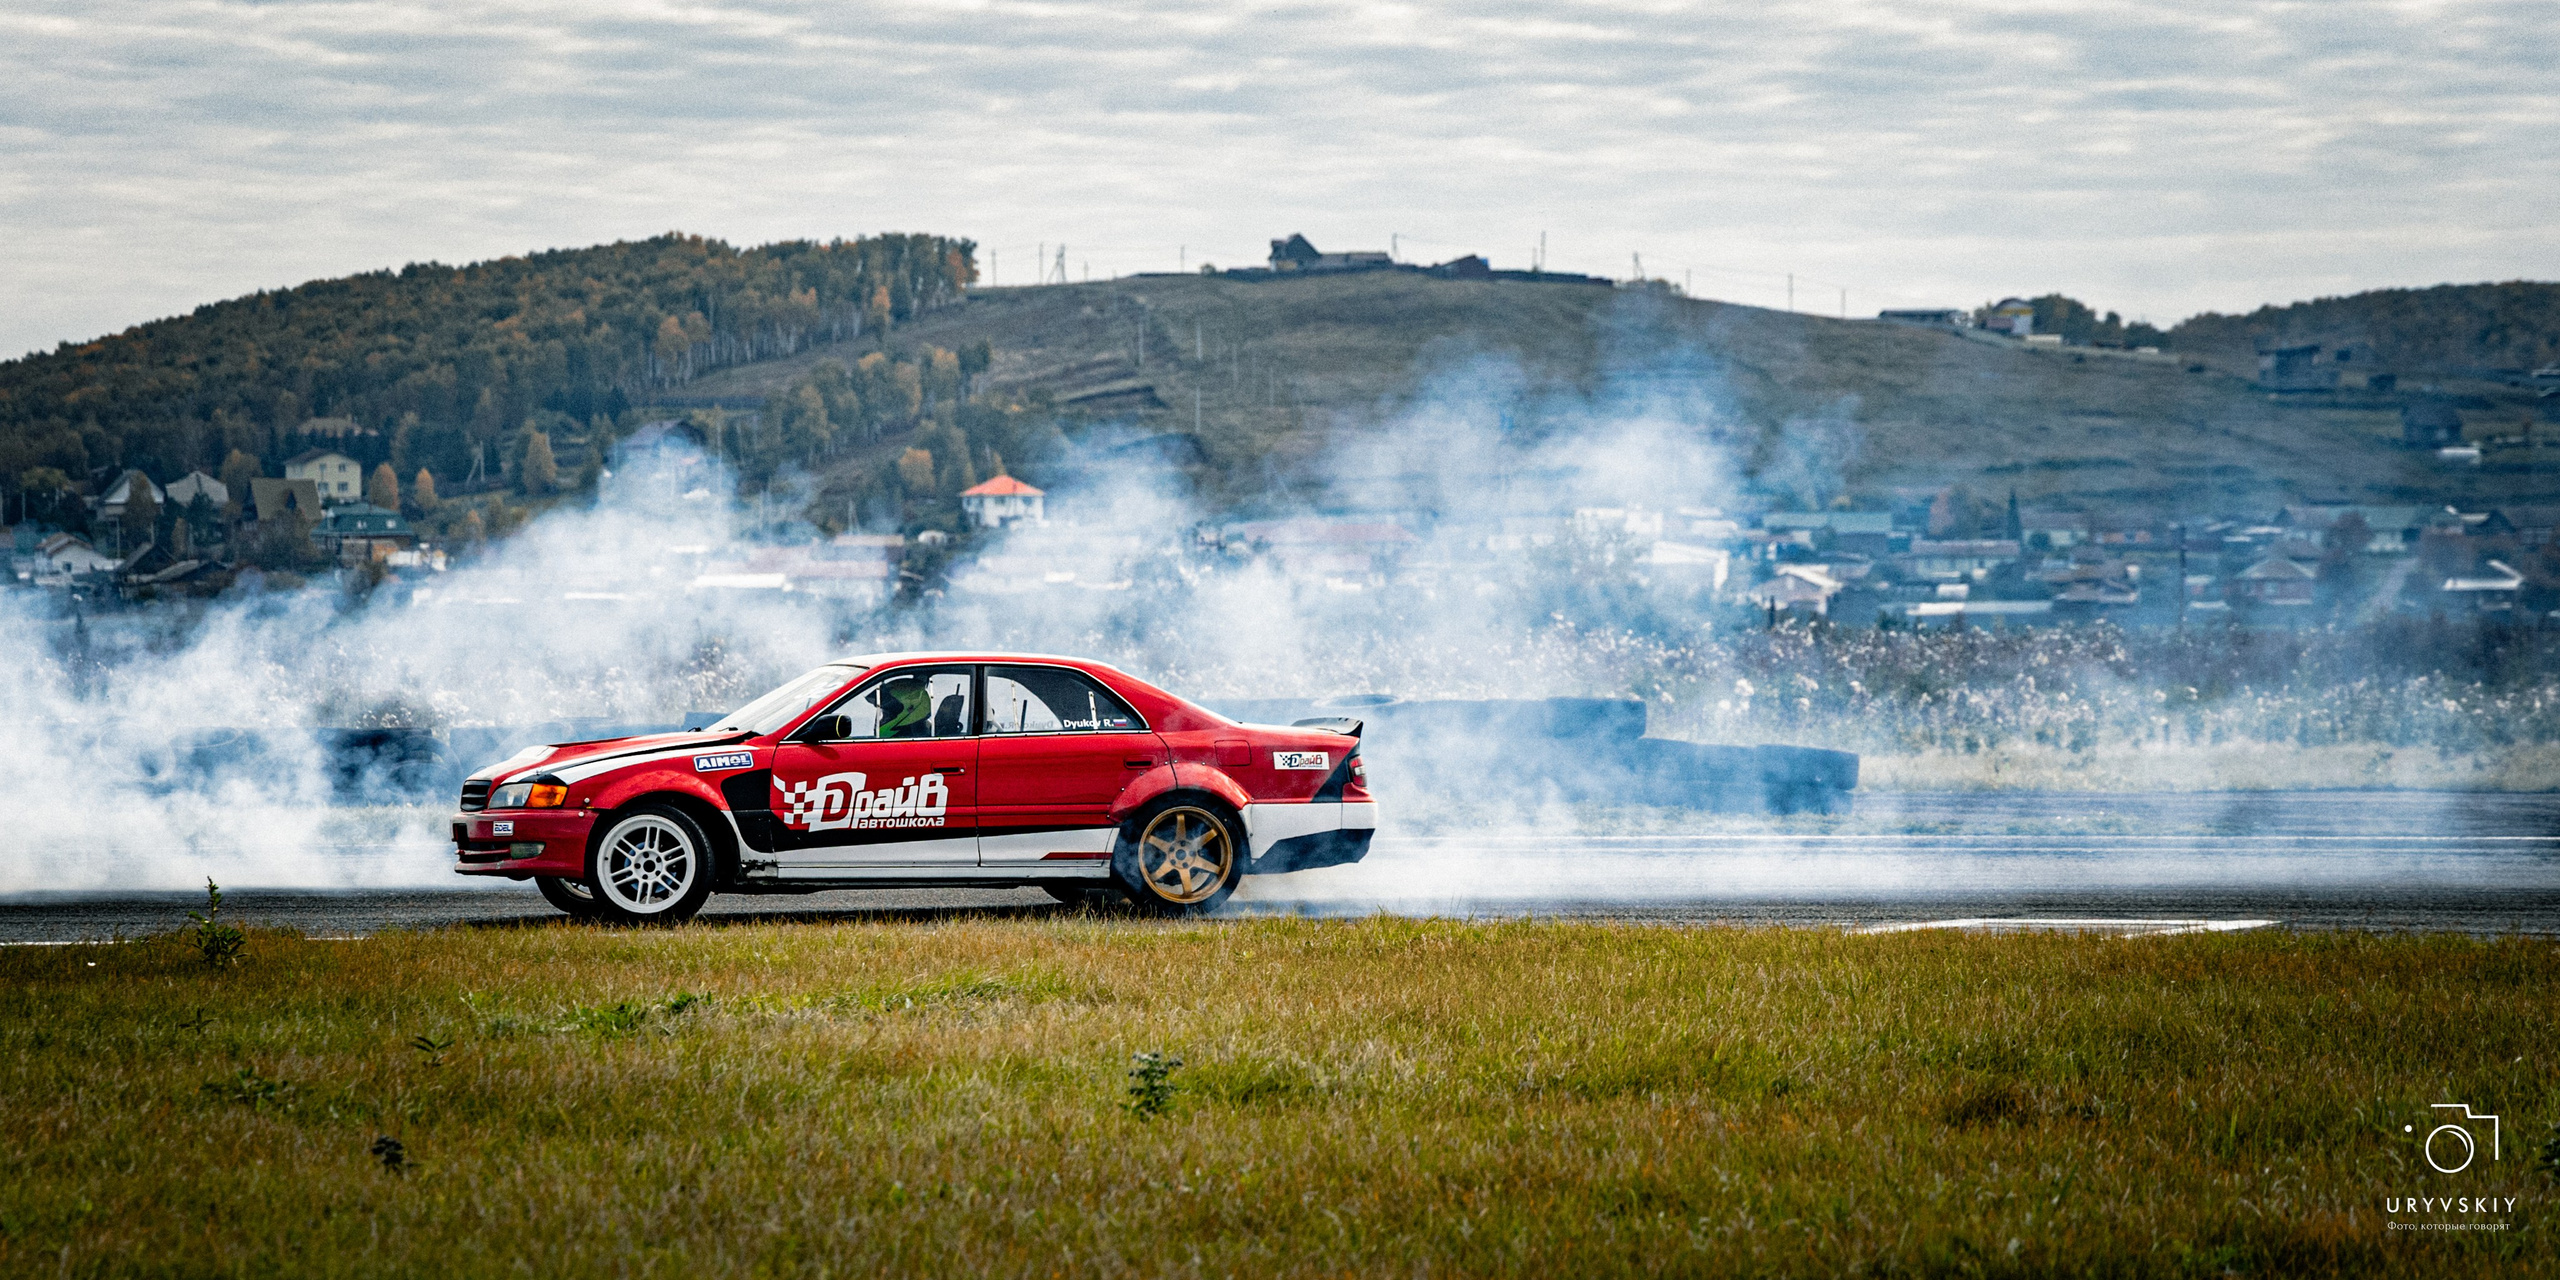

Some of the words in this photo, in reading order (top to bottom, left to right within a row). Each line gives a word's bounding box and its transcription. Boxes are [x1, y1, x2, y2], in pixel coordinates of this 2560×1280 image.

[1103, 719, 1114, 727] R.
[699, 755, 750, 768] AIMOL
[859, 817, 945, 829] автошкола
